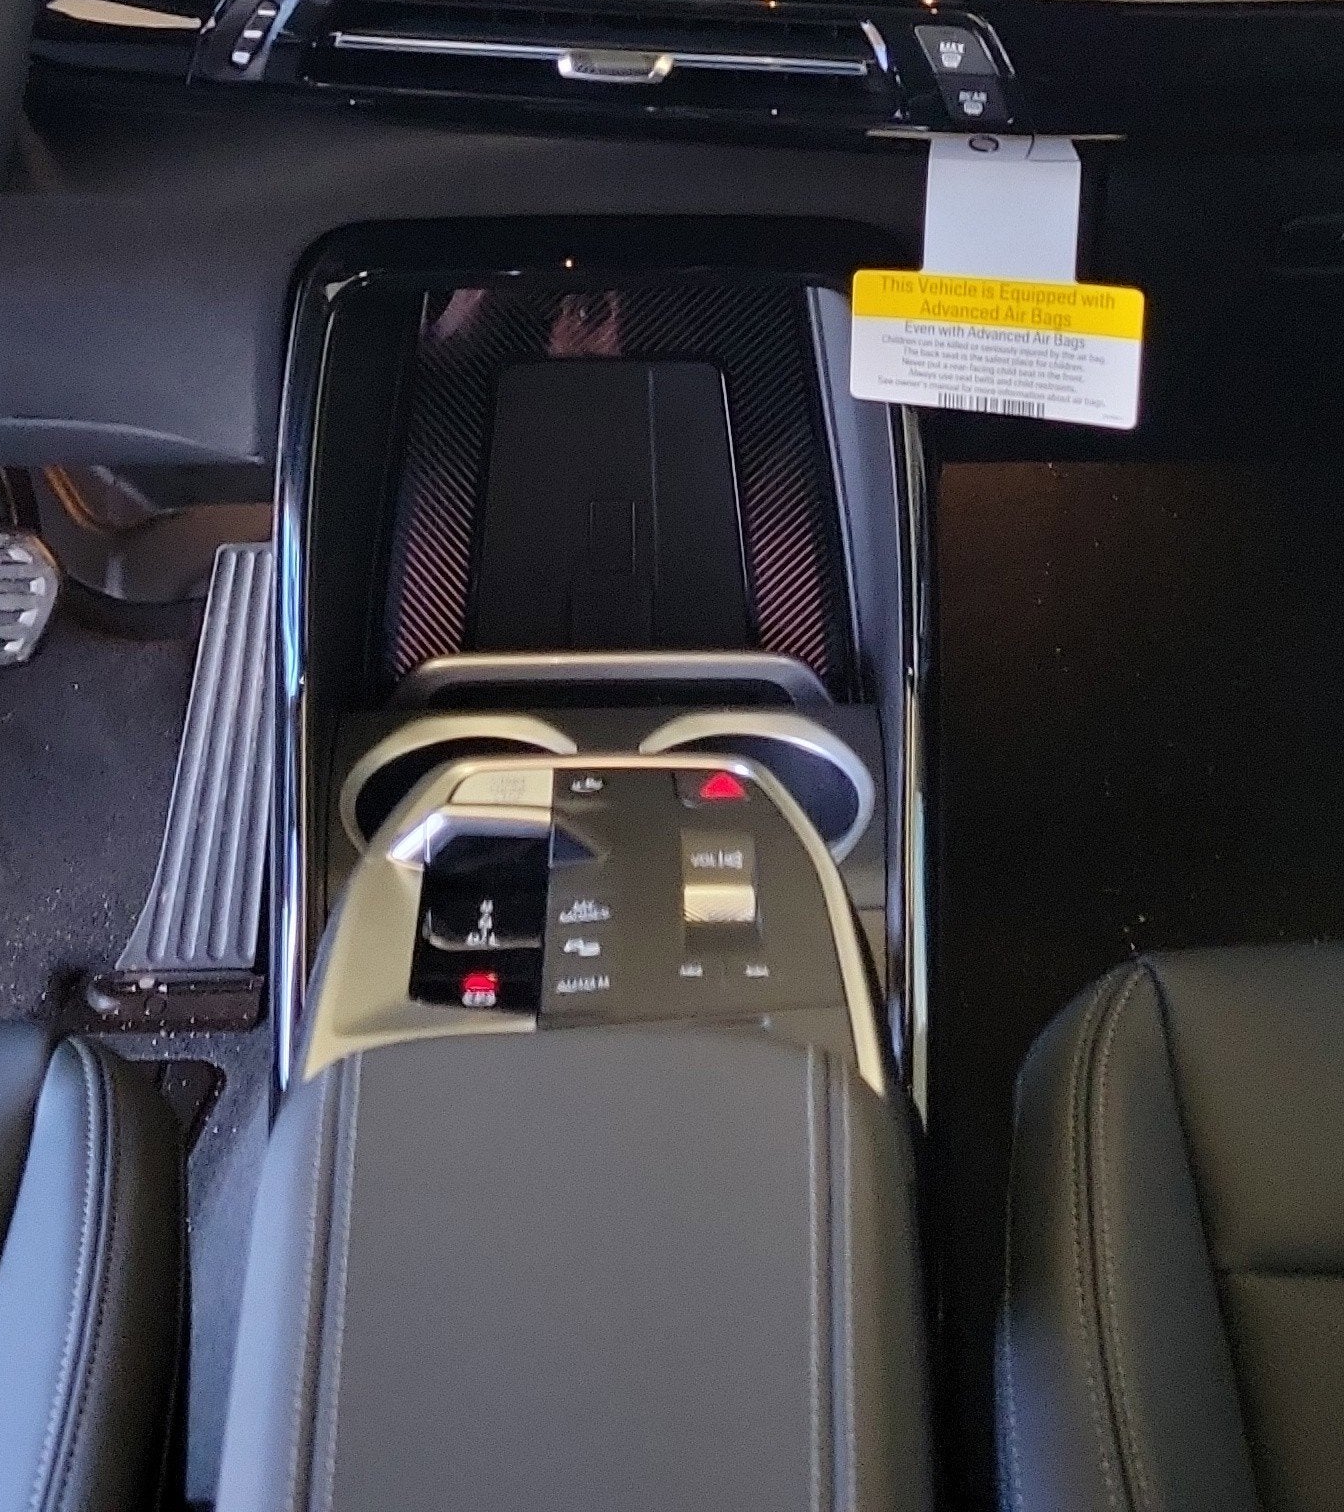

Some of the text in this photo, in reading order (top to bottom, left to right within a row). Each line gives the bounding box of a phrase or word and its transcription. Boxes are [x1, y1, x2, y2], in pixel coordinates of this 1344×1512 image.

[880, 275, 1115, 310] This Vehicle is Equipped with
[919, 299, 1072, 329] Advanced Air Bags
[904, 321, 1085, 351] Even with Advanced Air Bags
